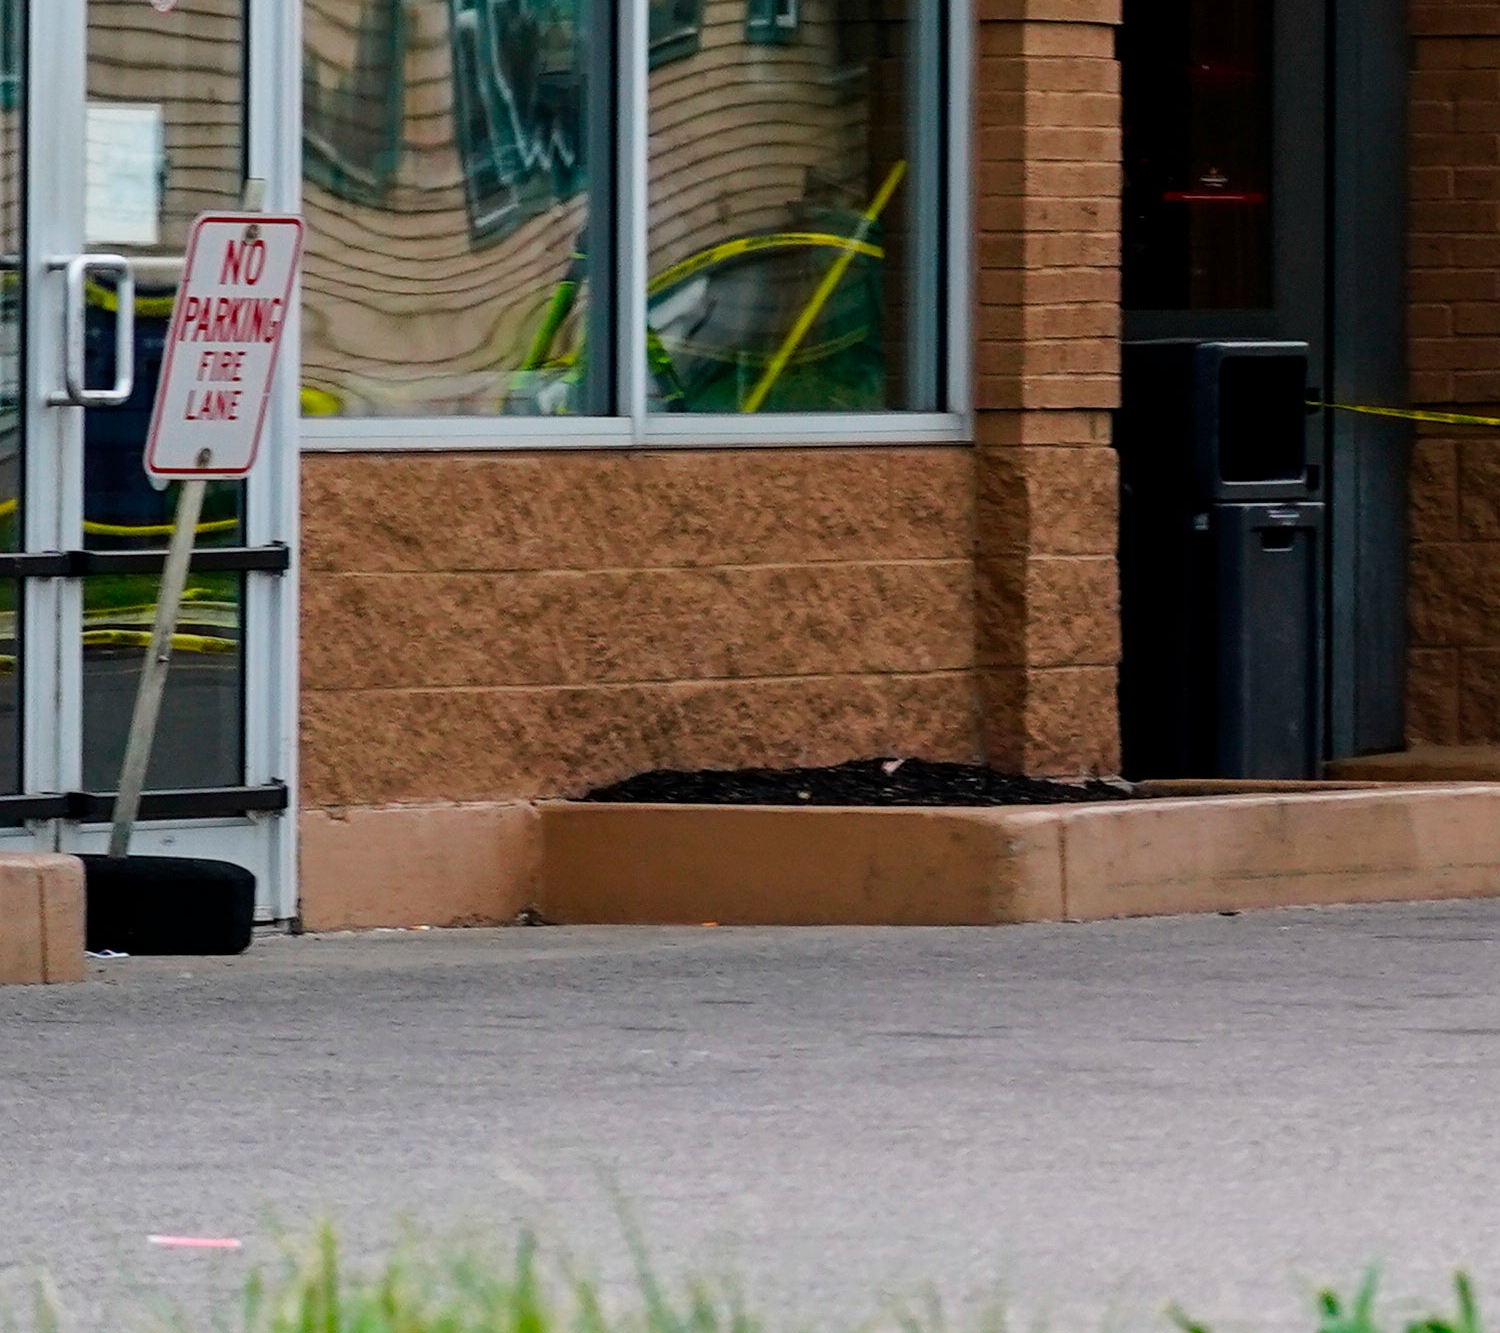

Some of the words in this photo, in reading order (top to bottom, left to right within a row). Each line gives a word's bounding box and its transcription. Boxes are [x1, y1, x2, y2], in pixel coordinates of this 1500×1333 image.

[219, 239, 267, 286] NO
[178, 296, 283, 344] PARKING
[196, 350, 249, 382] FIRE
[184, 390, 243, 422] LANE
